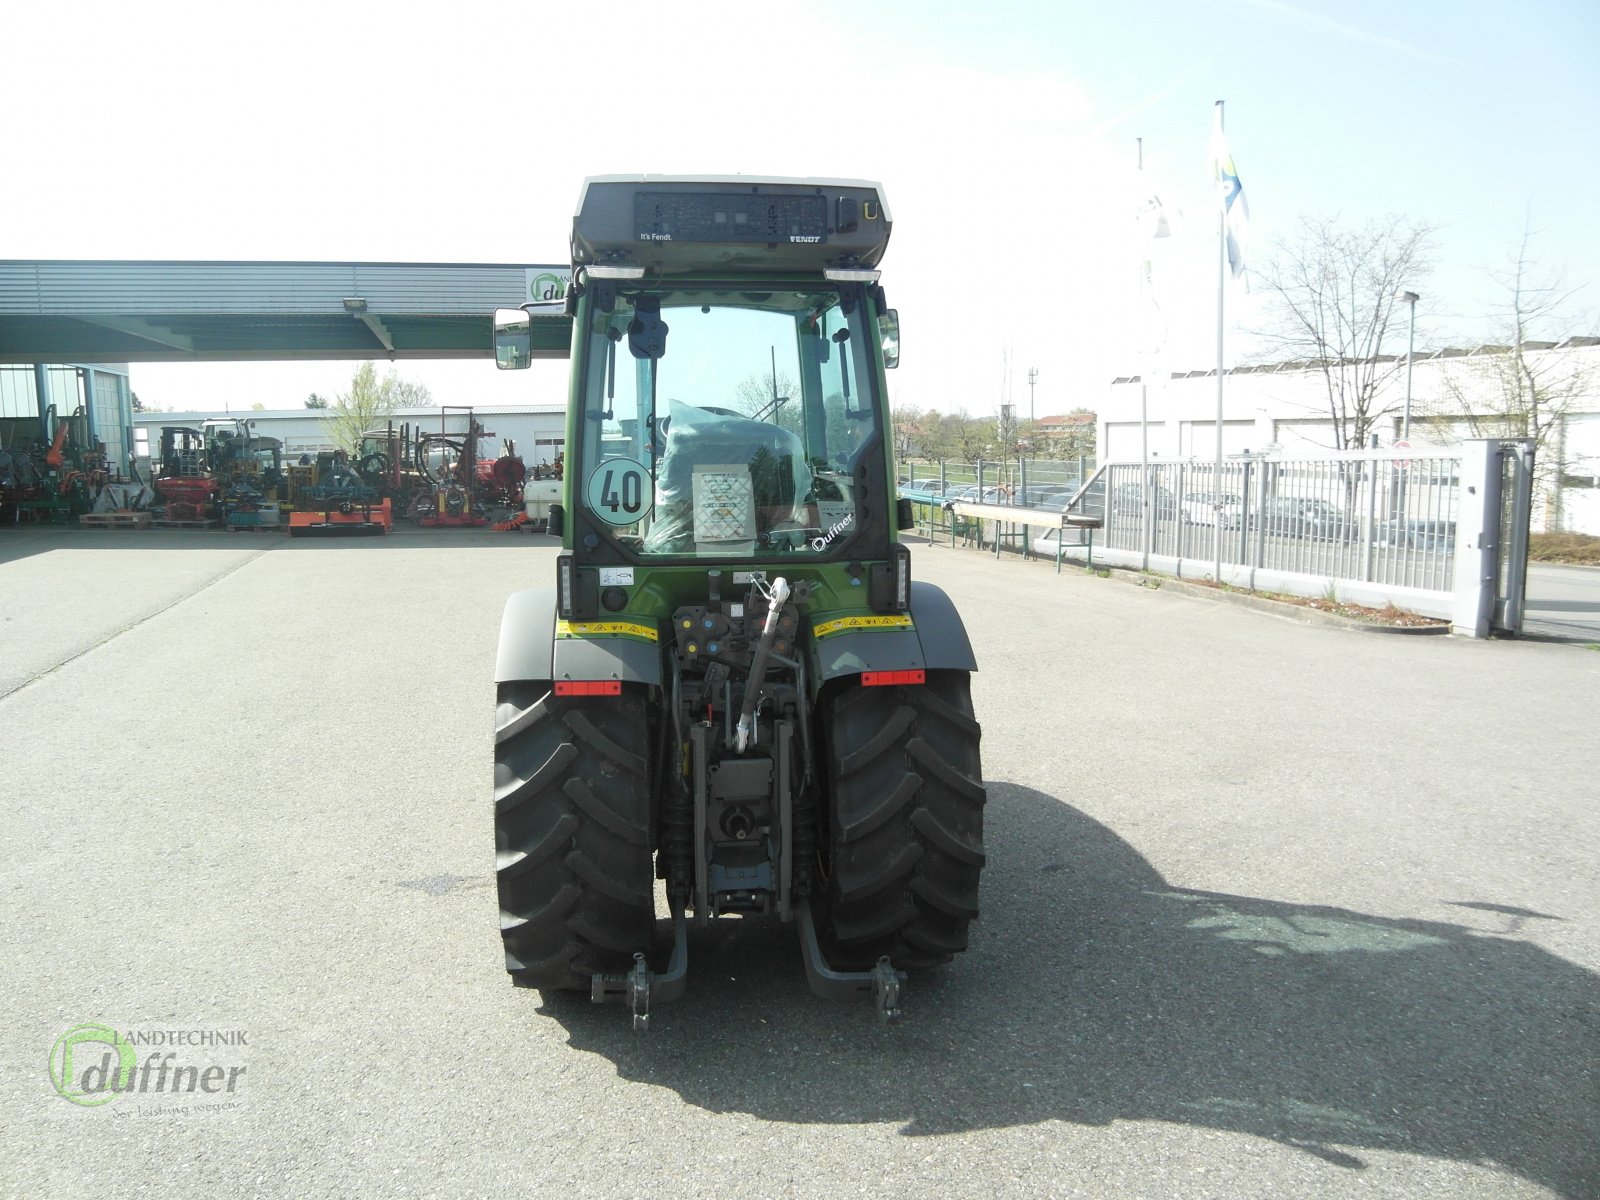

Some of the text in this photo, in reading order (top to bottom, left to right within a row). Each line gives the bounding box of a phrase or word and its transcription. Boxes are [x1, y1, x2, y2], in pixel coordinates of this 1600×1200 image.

[640, 232, 673, 241] It's Fendt.
[789, 235, 821, 243] FENDT
[600, 470, 642, 514] 40
